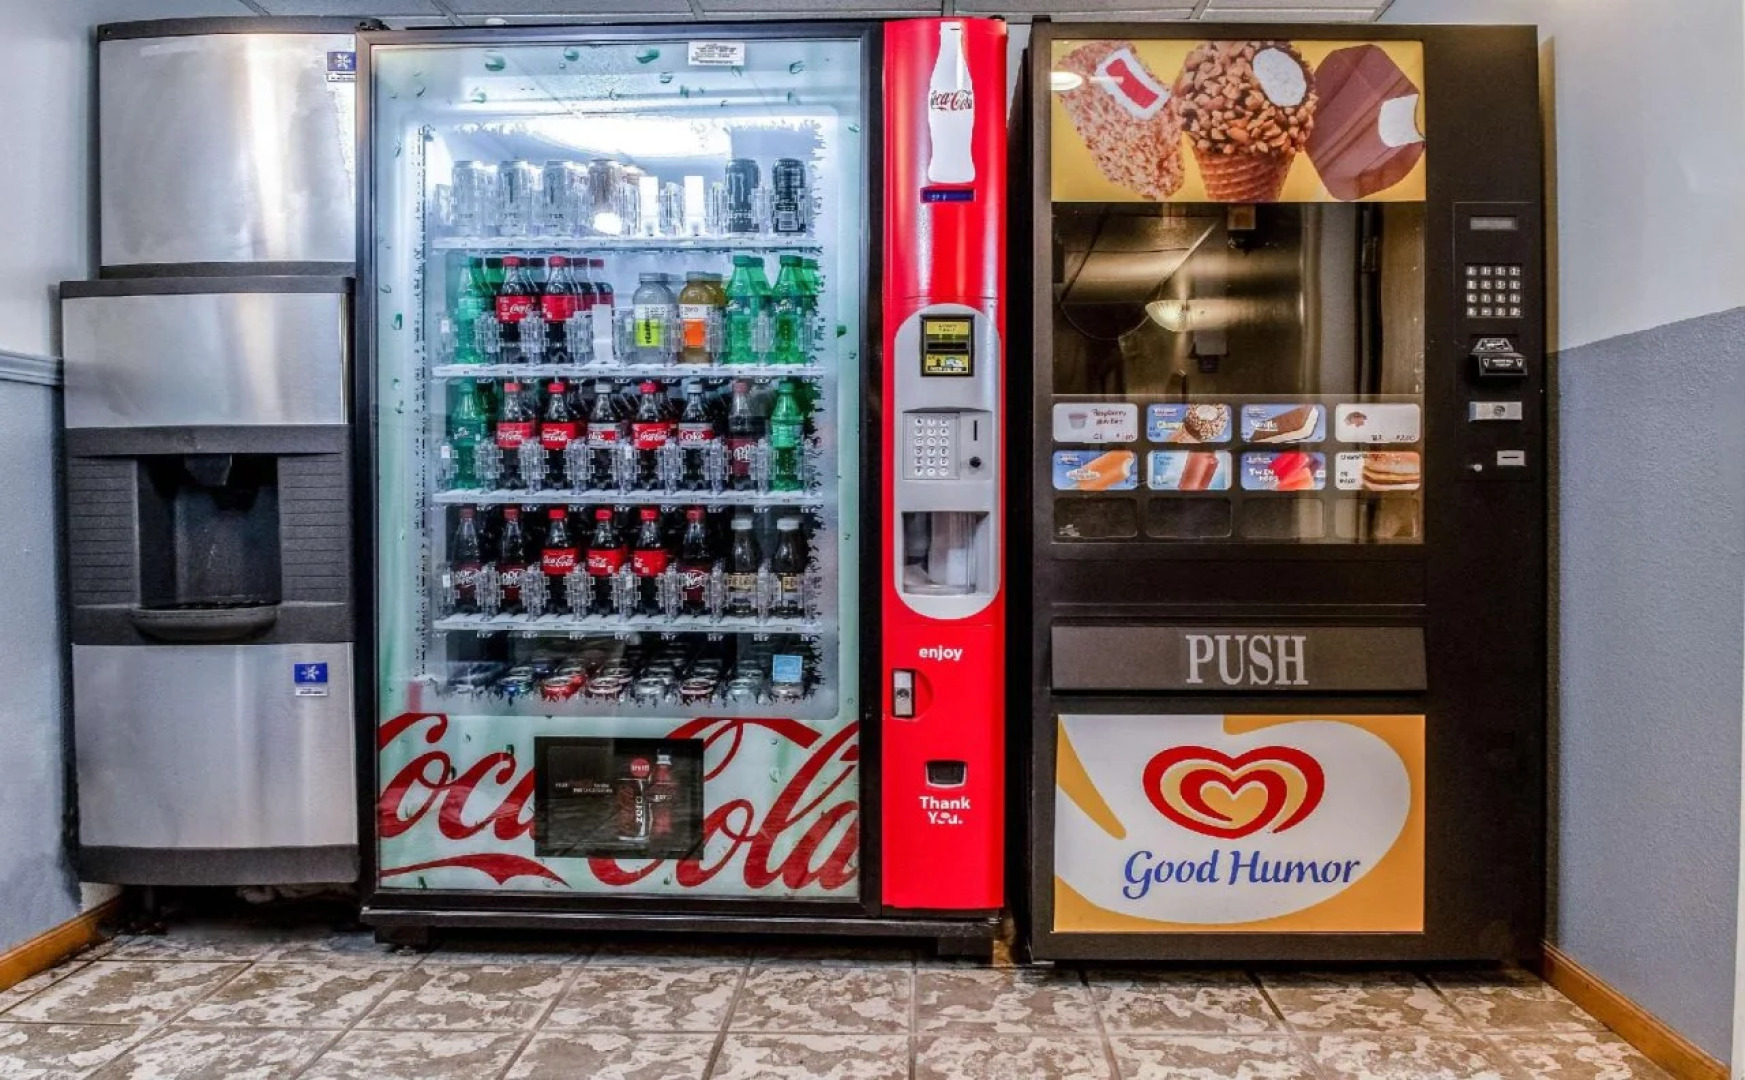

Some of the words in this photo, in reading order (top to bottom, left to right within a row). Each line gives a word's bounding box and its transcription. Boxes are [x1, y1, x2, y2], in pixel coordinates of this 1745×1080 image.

[919, 645, 963, 661] enjoy
[1186, 634, 1309, 686] PUSH
[919, 796, 970, 810] Thank
[1122, 849, 1219, 900] Good
[1228, 850, 1361, 886] Humor
